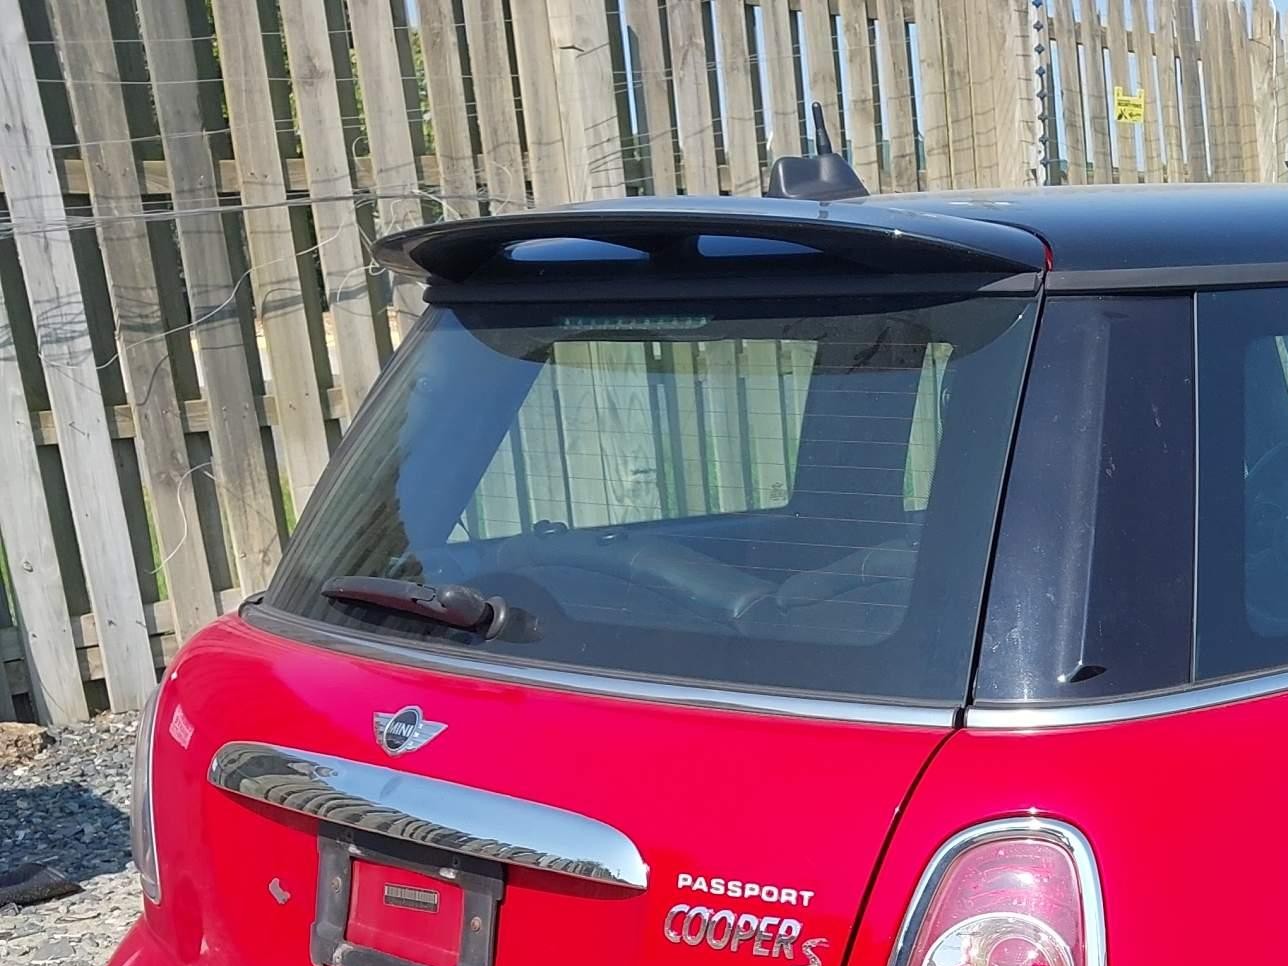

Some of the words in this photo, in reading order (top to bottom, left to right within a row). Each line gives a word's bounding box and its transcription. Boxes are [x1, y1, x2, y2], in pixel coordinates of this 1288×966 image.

[390, 721, 414, 737] MINI
[677, 873, 815, 907] PASSPORT
[664, 904, 803, 960] COOPER
